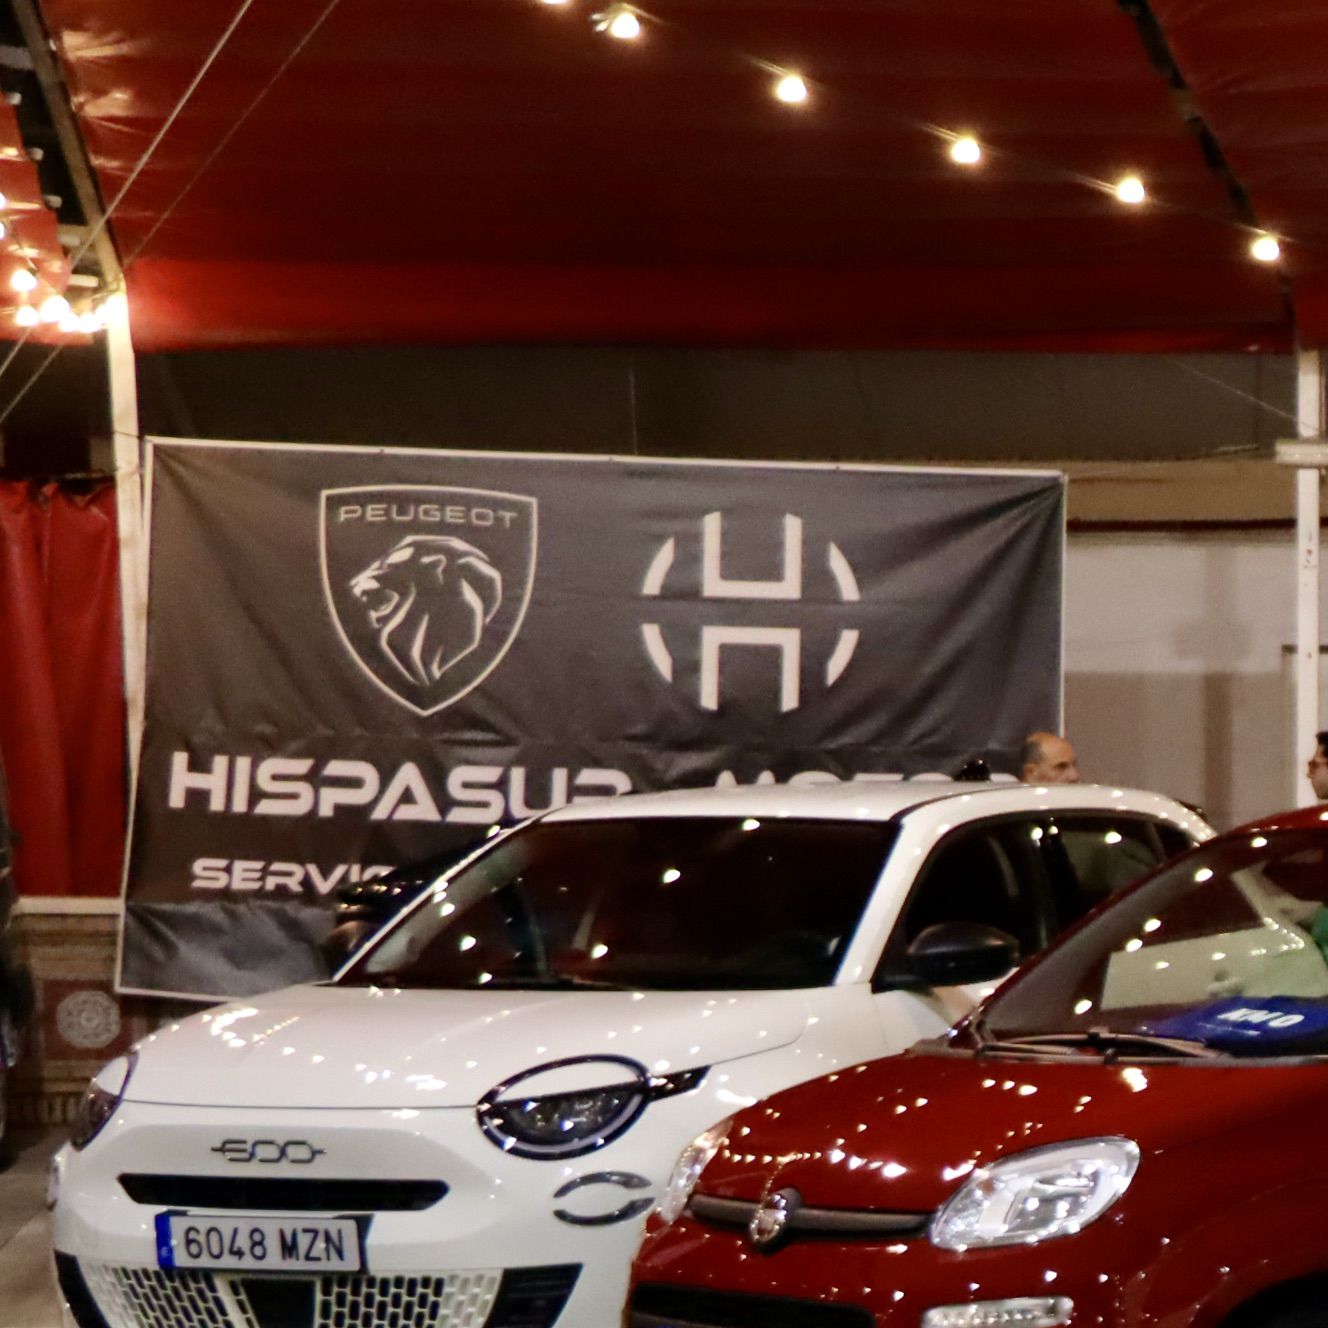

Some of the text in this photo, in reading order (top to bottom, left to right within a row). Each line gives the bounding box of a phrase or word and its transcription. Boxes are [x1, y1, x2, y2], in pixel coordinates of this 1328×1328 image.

[339, 503, 518, 528] PEUGEOT
[184, 1226, 345, 1262] 6048 MZN
